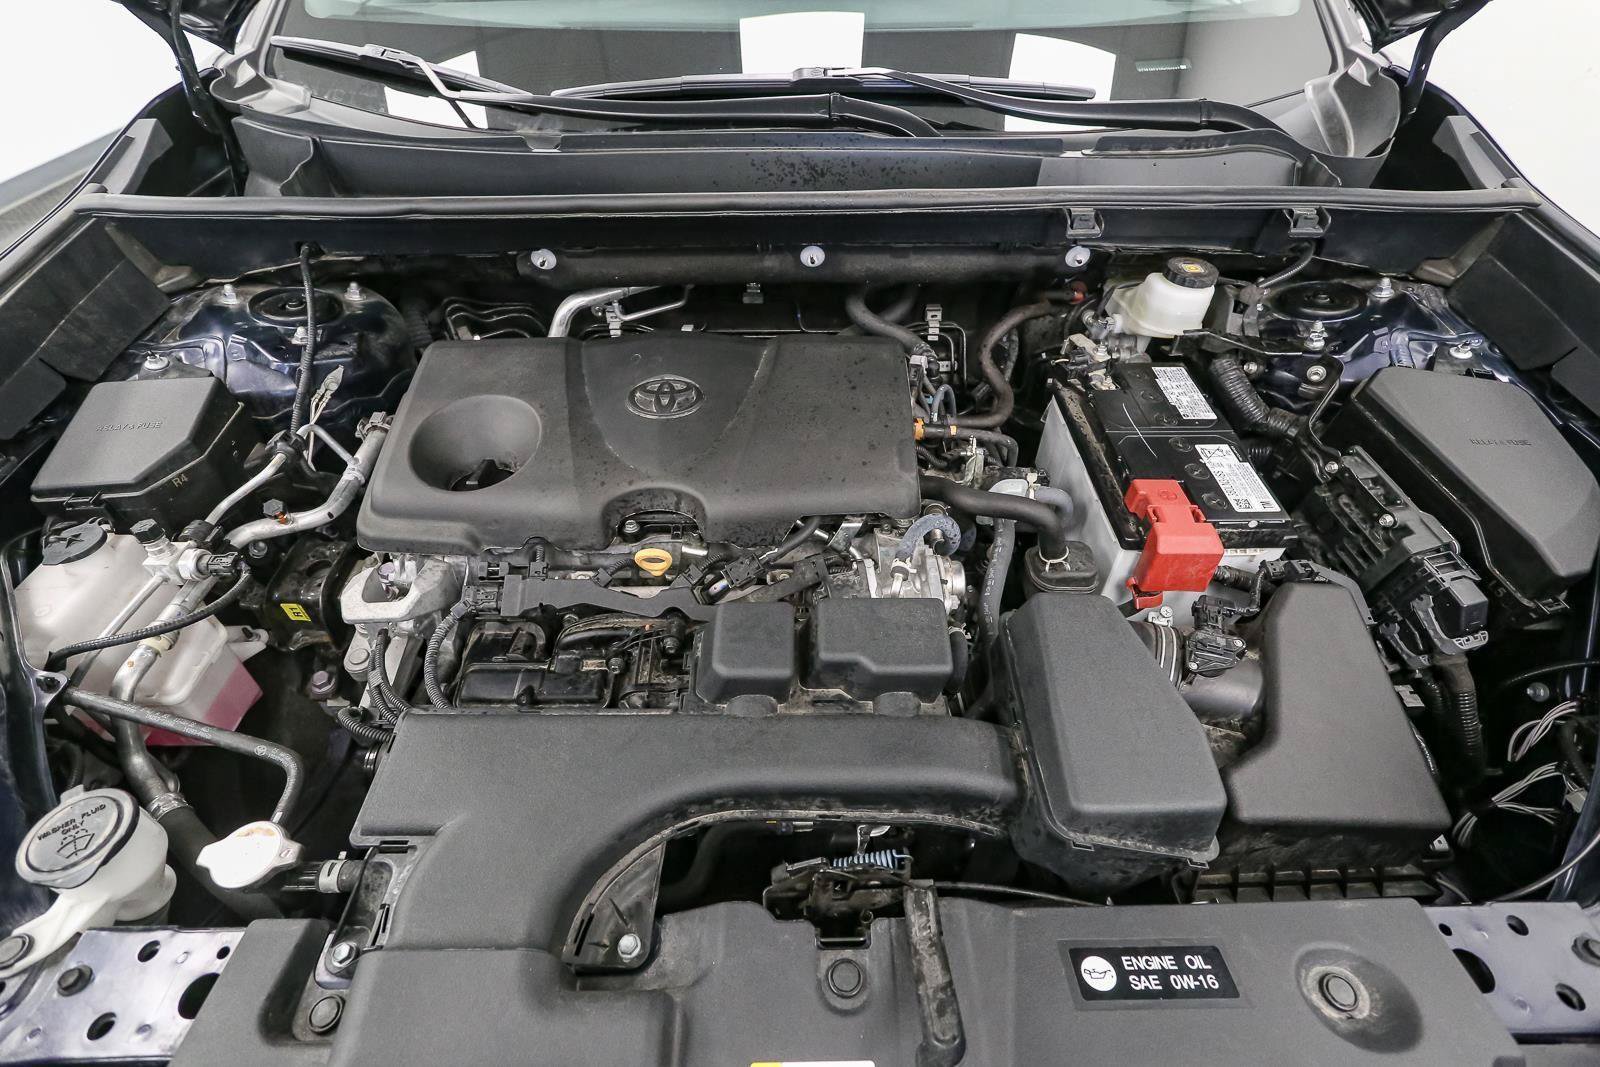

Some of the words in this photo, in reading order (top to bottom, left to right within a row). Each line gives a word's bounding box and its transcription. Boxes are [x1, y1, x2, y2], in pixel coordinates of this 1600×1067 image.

[172, 474, 188, 487] R4
[38, 819, 76, 840] WASHER
[81, 804, 106, 819] FLUID
[61, 820, 84, 835] ONLY
[1121, 955, 1178, 970] ENGINE
[1185, 955, 1212, 970] OIL
[1129, 975, 1162, 990] SAE
[1170, 974, 1220, 990] 0W-16
